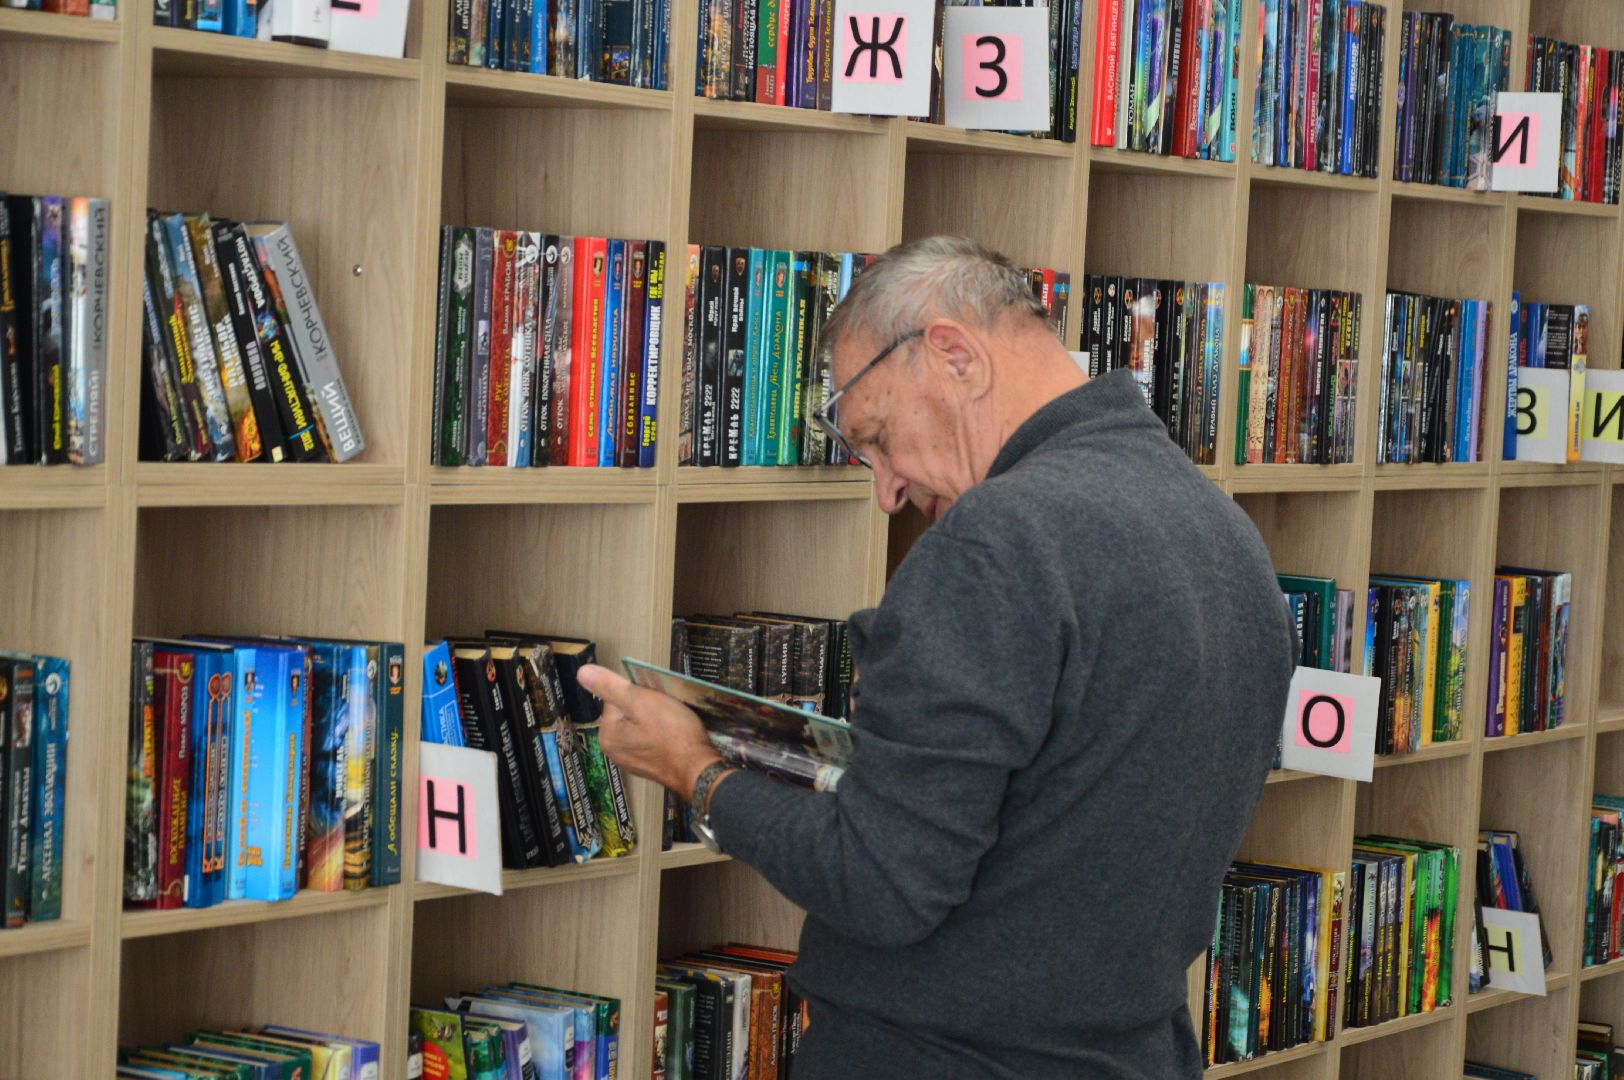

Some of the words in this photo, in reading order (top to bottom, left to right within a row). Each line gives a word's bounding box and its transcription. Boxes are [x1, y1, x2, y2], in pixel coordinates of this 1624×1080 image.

[845, 16, 904, 79] Ж
[975, 36, 1008, 97] З
[1106, 55, 1115, 101] ВАСИЛИЙ
[1492, 115, 1530, 164] И
[93, 207, 106, 344] КОРЧЕВСКИЙ
[277, 235, 327, 356] КОРЧЕВСКИЙ
[645, 305, 661, 405] КОРРЕКТИРОВЩИК
[1510, 332, 1518, 377] ДРАКОНА
[321, 382, 355, 452] ВЕЩИЙ
[705, 384, 713, 409] 2222
[731, 387, 741, 410] 2222
[1507, 378, 1517, 418] ЖЕРТВЫ
[702, 410, 712, 457] КРЕМЛЬ
[728, 413, 738, 460] КРЕМЛЬ
[781, 642, 789, 685] КУЯВИЯ
[1302, 695, 1346, 748] О
[169, 776, 181, 865] ВОСХОЖДЕНИЕ
[427, 780, 466, 854] Н
[1485, 927, 1515, 972] Н
